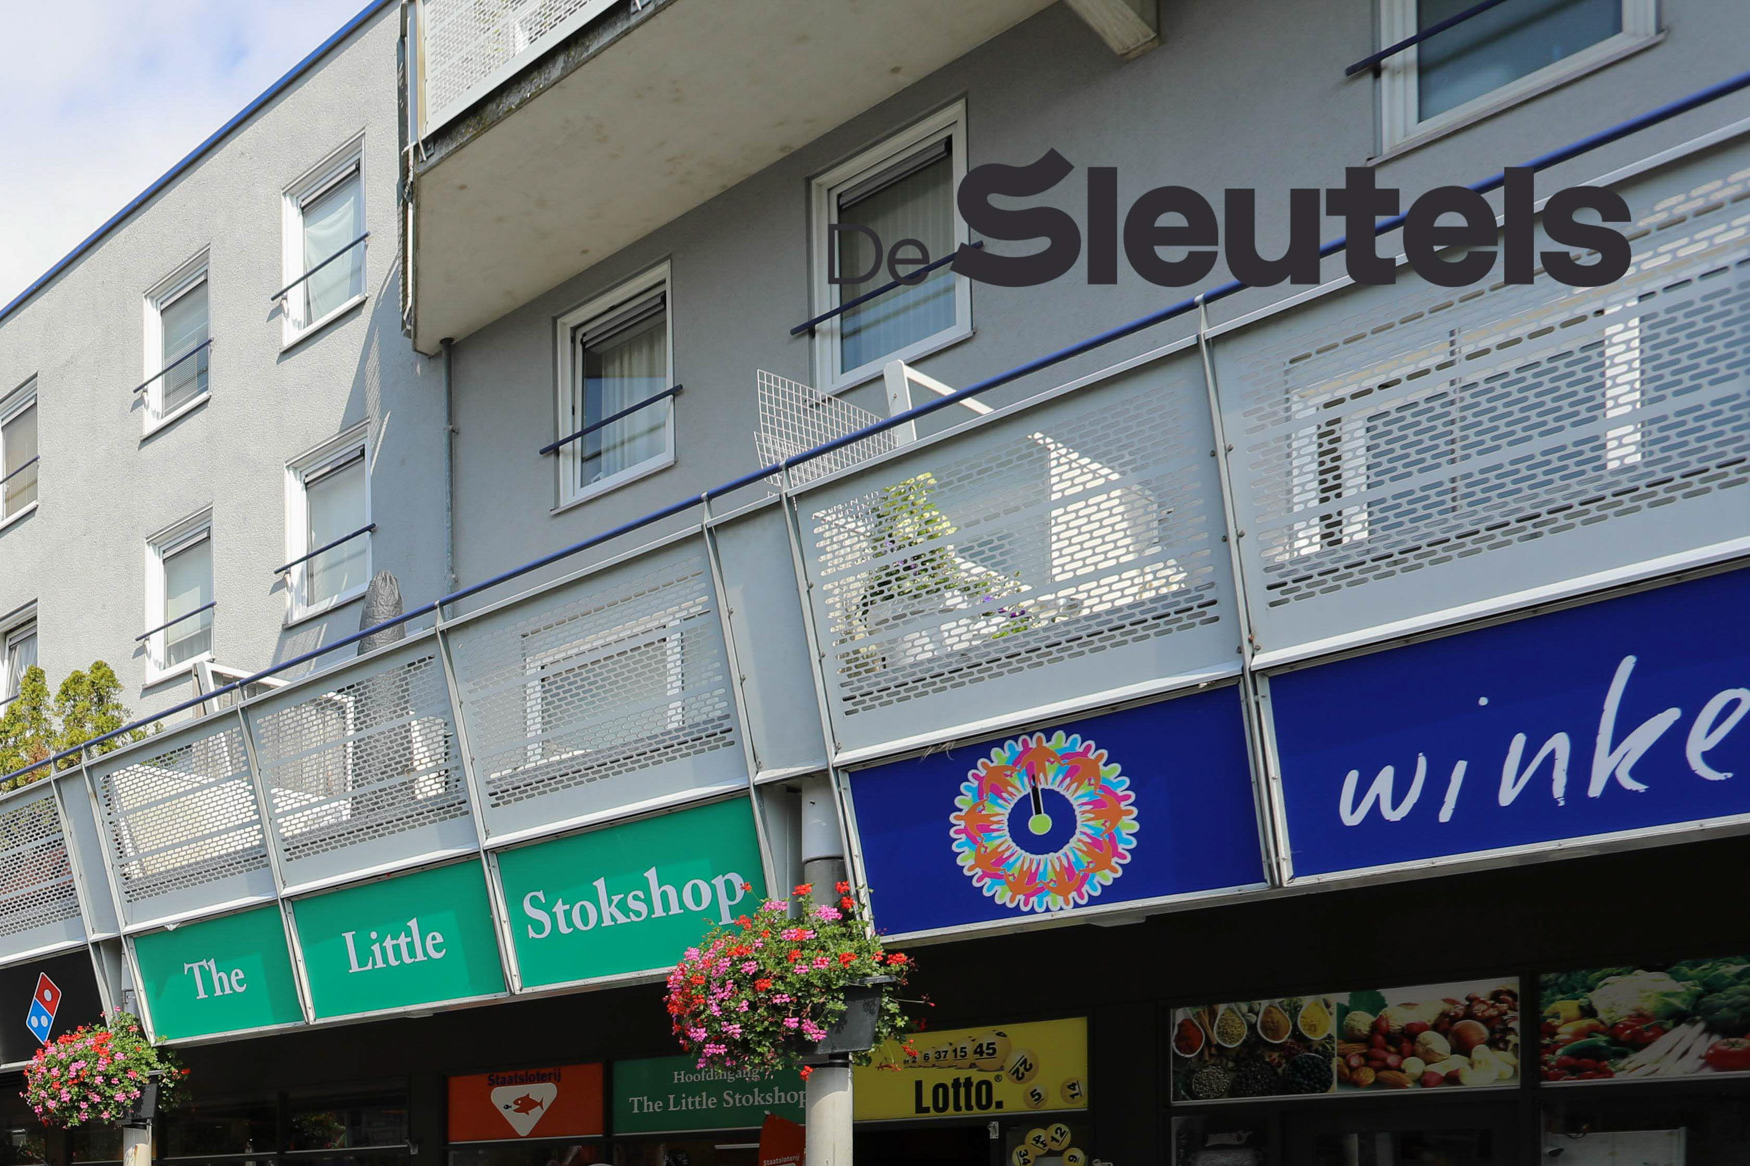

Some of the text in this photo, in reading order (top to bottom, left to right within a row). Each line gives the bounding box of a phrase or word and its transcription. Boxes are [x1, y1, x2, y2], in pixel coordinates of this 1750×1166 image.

[184, 865, 747, 1000] The Little Stokshop
[935, 1050, 948, 1060] 37
[952, 1046, 967, 1058] 15
[973, 1041, 997, 1057] 45
[487, 1068, 561, 1087] Staatsloterij
[629, 1096, 663, 1113] The
[668, 1091, 717, 1112] Little
[1030, 1088, 1043, 1103] 5
[763, 1154, 800, 1166] Staatsloterij
